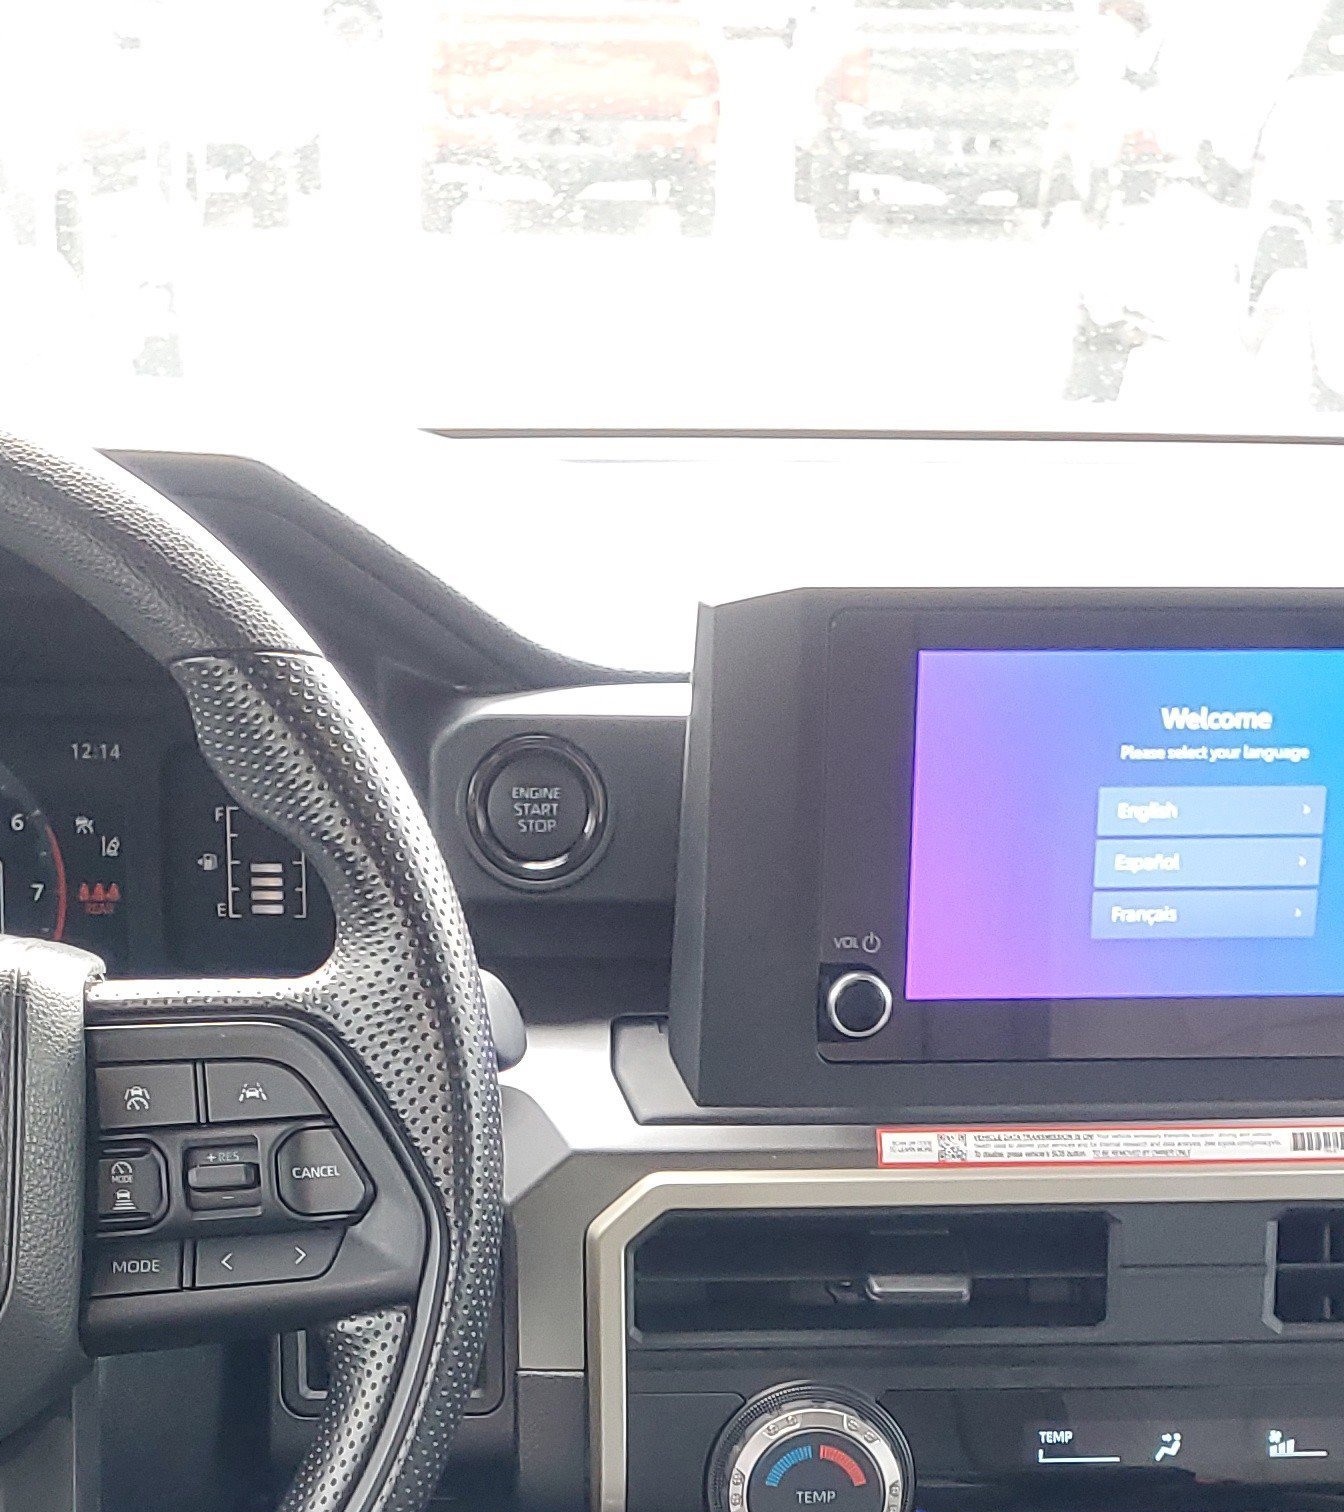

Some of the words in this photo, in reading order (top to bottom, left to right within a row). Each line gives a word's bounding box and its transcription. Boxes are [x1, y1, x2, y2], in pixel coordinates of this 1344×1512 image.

[1160, 706, 1273, 730] Welcome
[1120, 744, 1166, 760] Please
[1167, 744, 1209, 760] select
[1209, 747, 1242, 763] your
[1243, 743, 1311, 763] language
[511, 787, 562, 799] ENGINE
[215, 806, 224, 822] F
[513, 803, 559, 816] START
[1117, 801, 1179, 823] English
[10, 813, 24, 831] 6
[517, 819, 557, 833] STOP
[1114, 852, 1181, 874] Español
[30, 883, 45, 901] 7
[217, 903, 227, 917] E
[1111, 905, 1178, 927] Français
[833, 936, 859, 949] VOL
[291, 1165, 341, 1179] CANCEL
[112, 1259, 161, 1275] MODE
[1038, 1430, 1074, 1444] TEMP
[796, 1490, 836, 1504] TEMP
